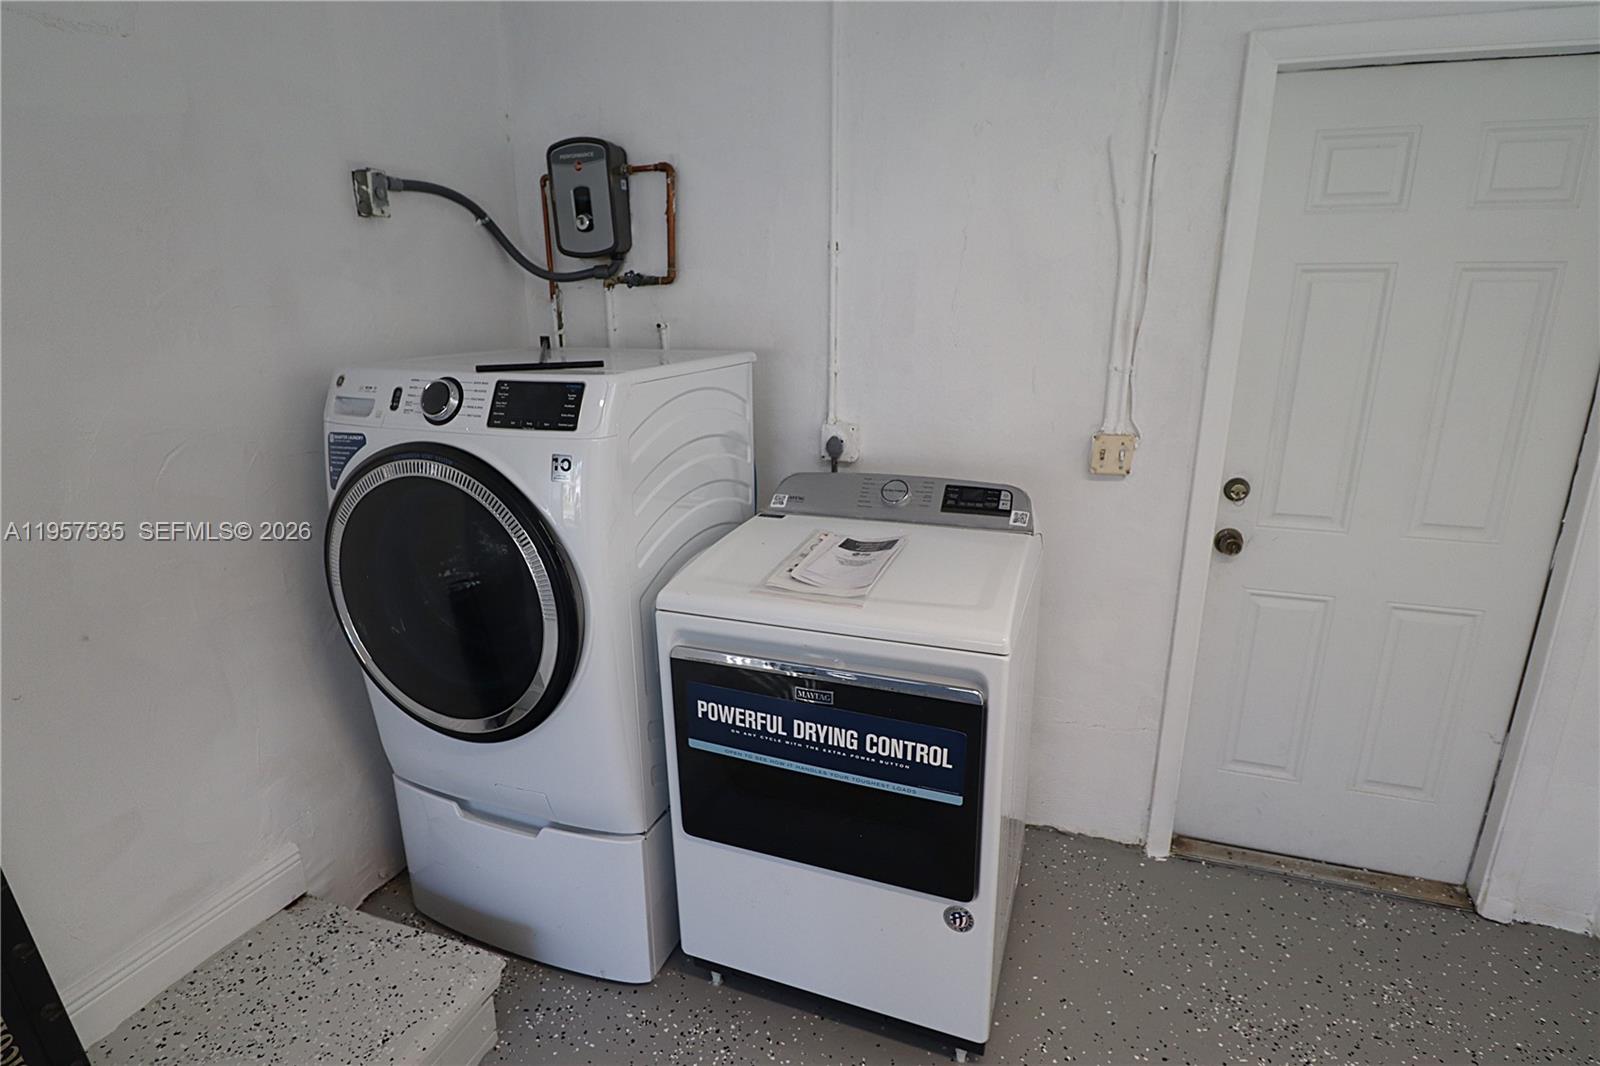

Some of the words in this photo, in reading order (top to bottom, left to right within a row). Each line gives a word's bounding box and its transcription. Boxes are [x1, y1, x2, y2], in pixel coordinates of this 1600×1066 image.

[552, 457, 572, 472] 10
[796, 688, 832, 703] MAYTAG
[697, 699, 787, 736] POWERFUL
[793, 719, 858, 751] DRYING
[865, 733, 953, 769] CONTROL
[759, 735, 782, 744] CYCLE
[784, 740, 803, 748] WITH
[805, 744, 819, 752] THE
[822, 748, 847, 757] EXTRA
[850, 754, 876, 763] POWER
[879, 759, 910, 770] BUTTON
[769, 757, 785, 767] HOW
[795, 762, 829, 777] HANDLES
[829, 771, 850, 782] YOUR
[851, 776, 890, 790] TOUGHEST
[892, 785, 918, 795] LOADS
